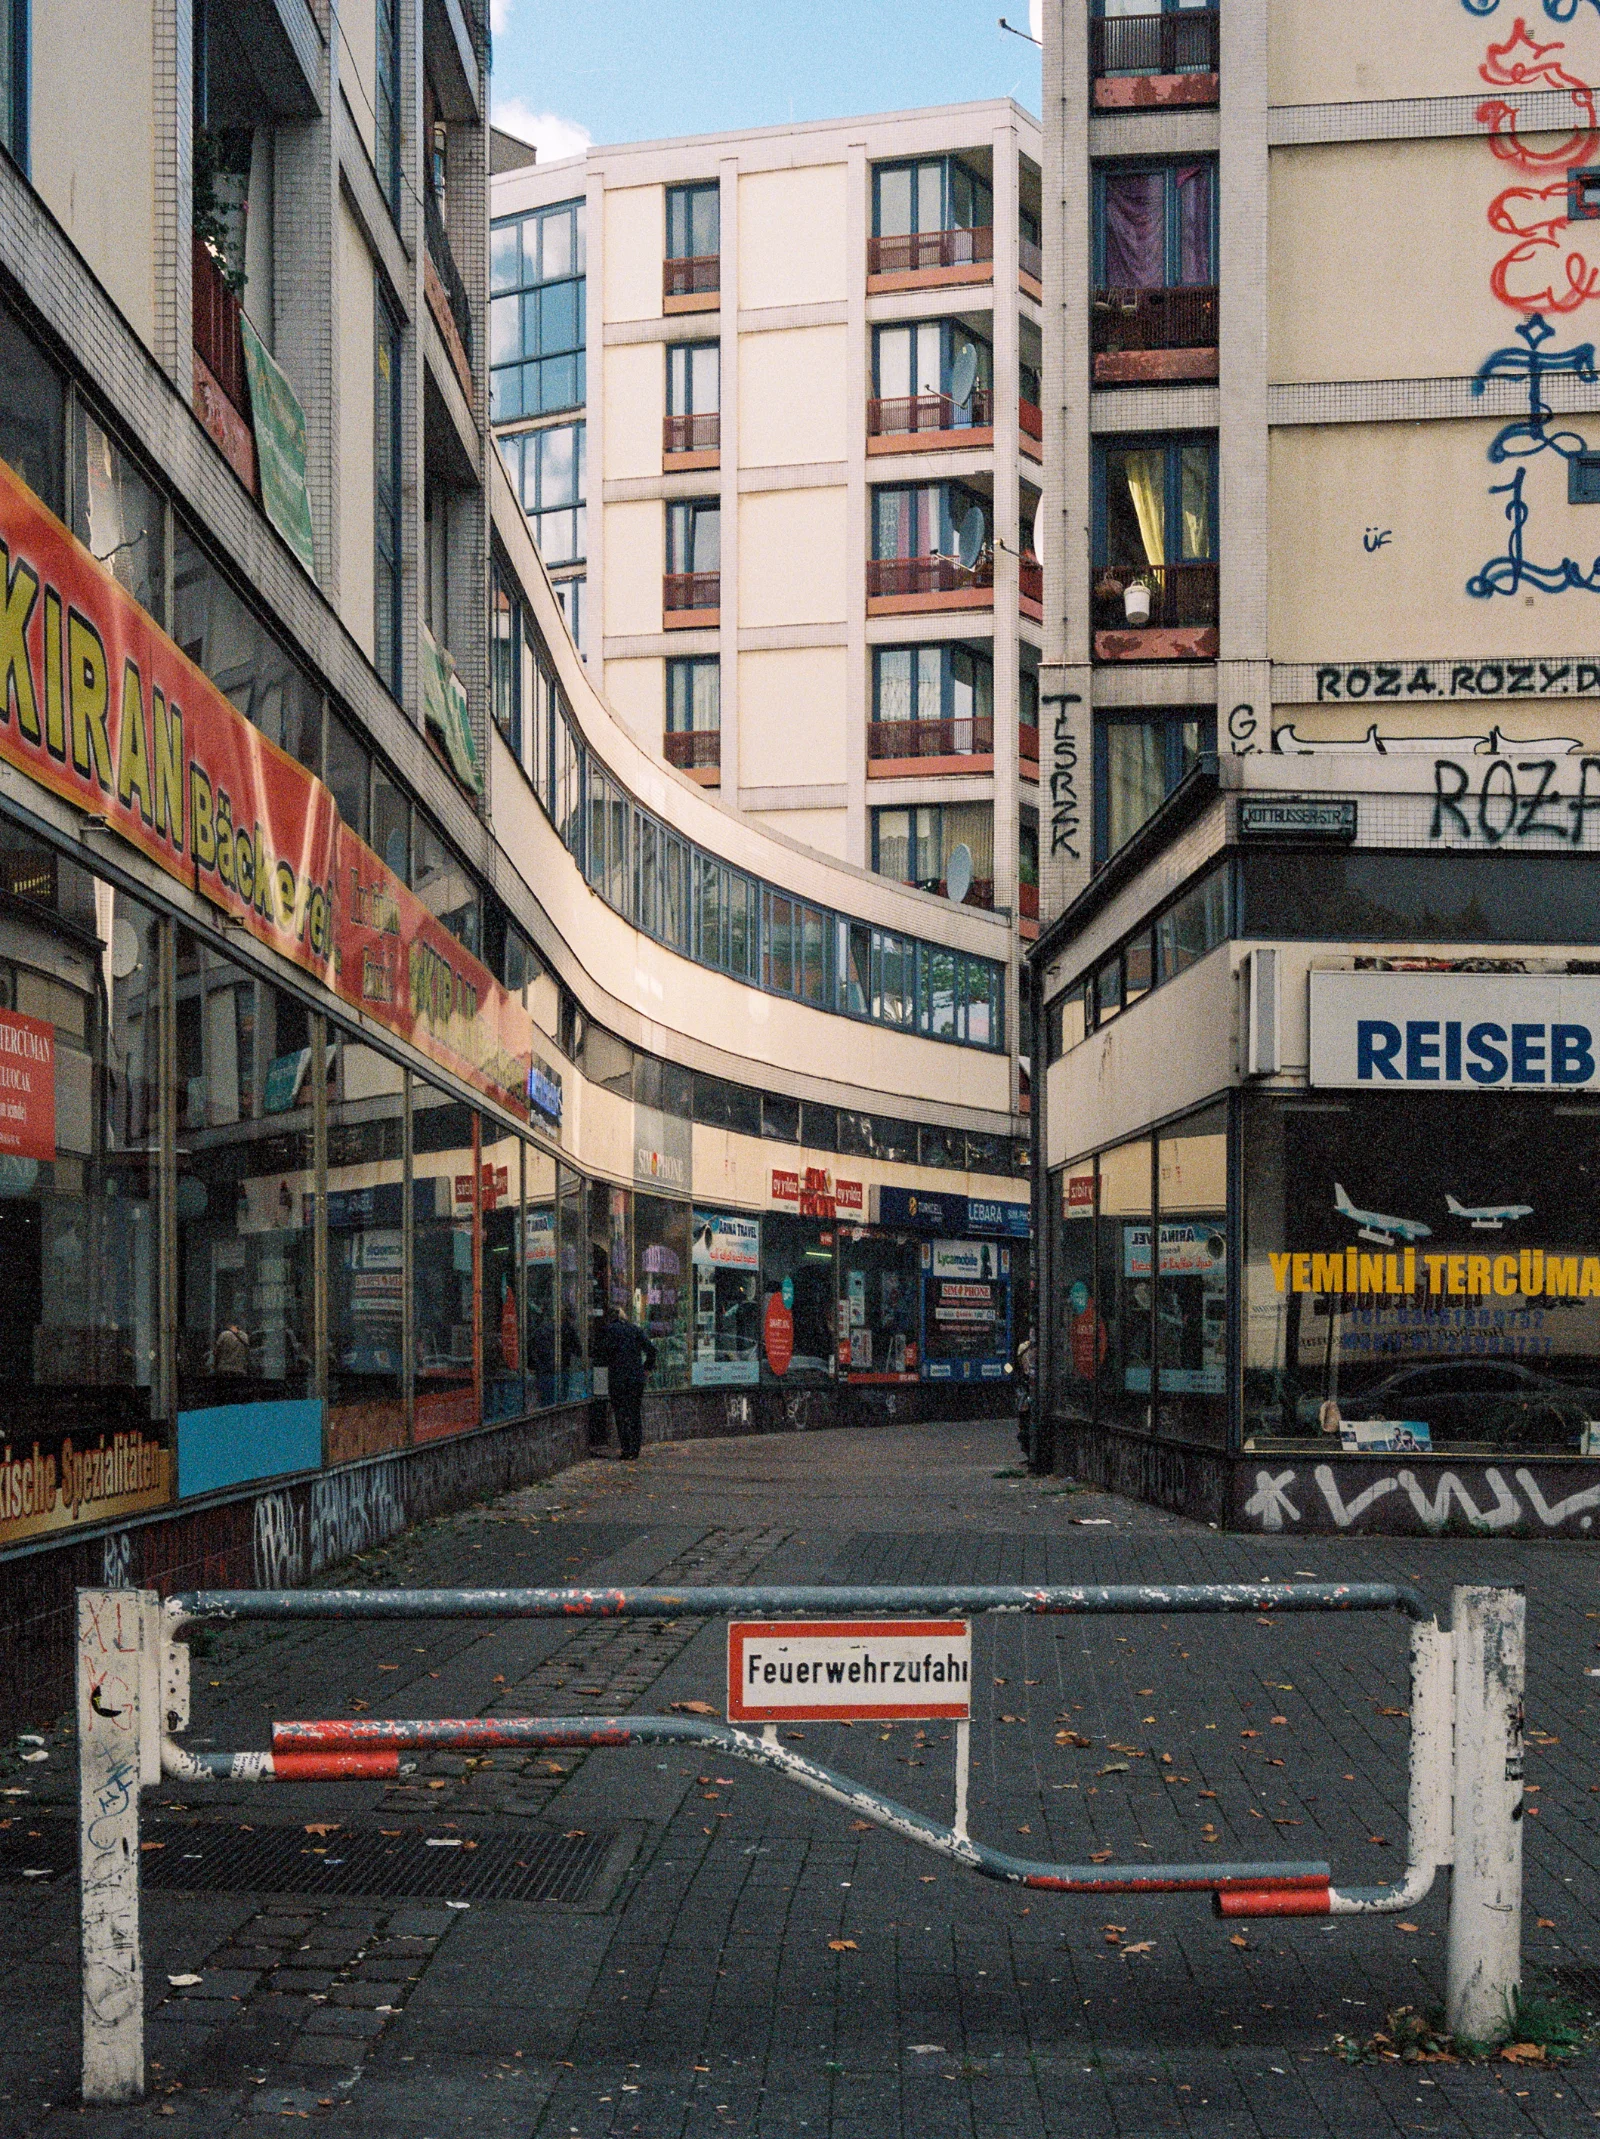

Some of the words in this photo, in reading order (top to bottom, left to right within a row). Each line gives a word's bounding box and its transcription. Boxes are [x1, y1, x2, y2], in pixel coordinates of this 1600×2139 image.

[1358, 1021, 1595, 1084] REISEB
[968, 1203, 1003, 1223] LEBARA
[1268, 1246, 1416, 1295] YEMİNLİ
[1424, 1249, 1600, 1297] TERCÜMA
[61, 1430, 160, 1520] Spezialitäten
